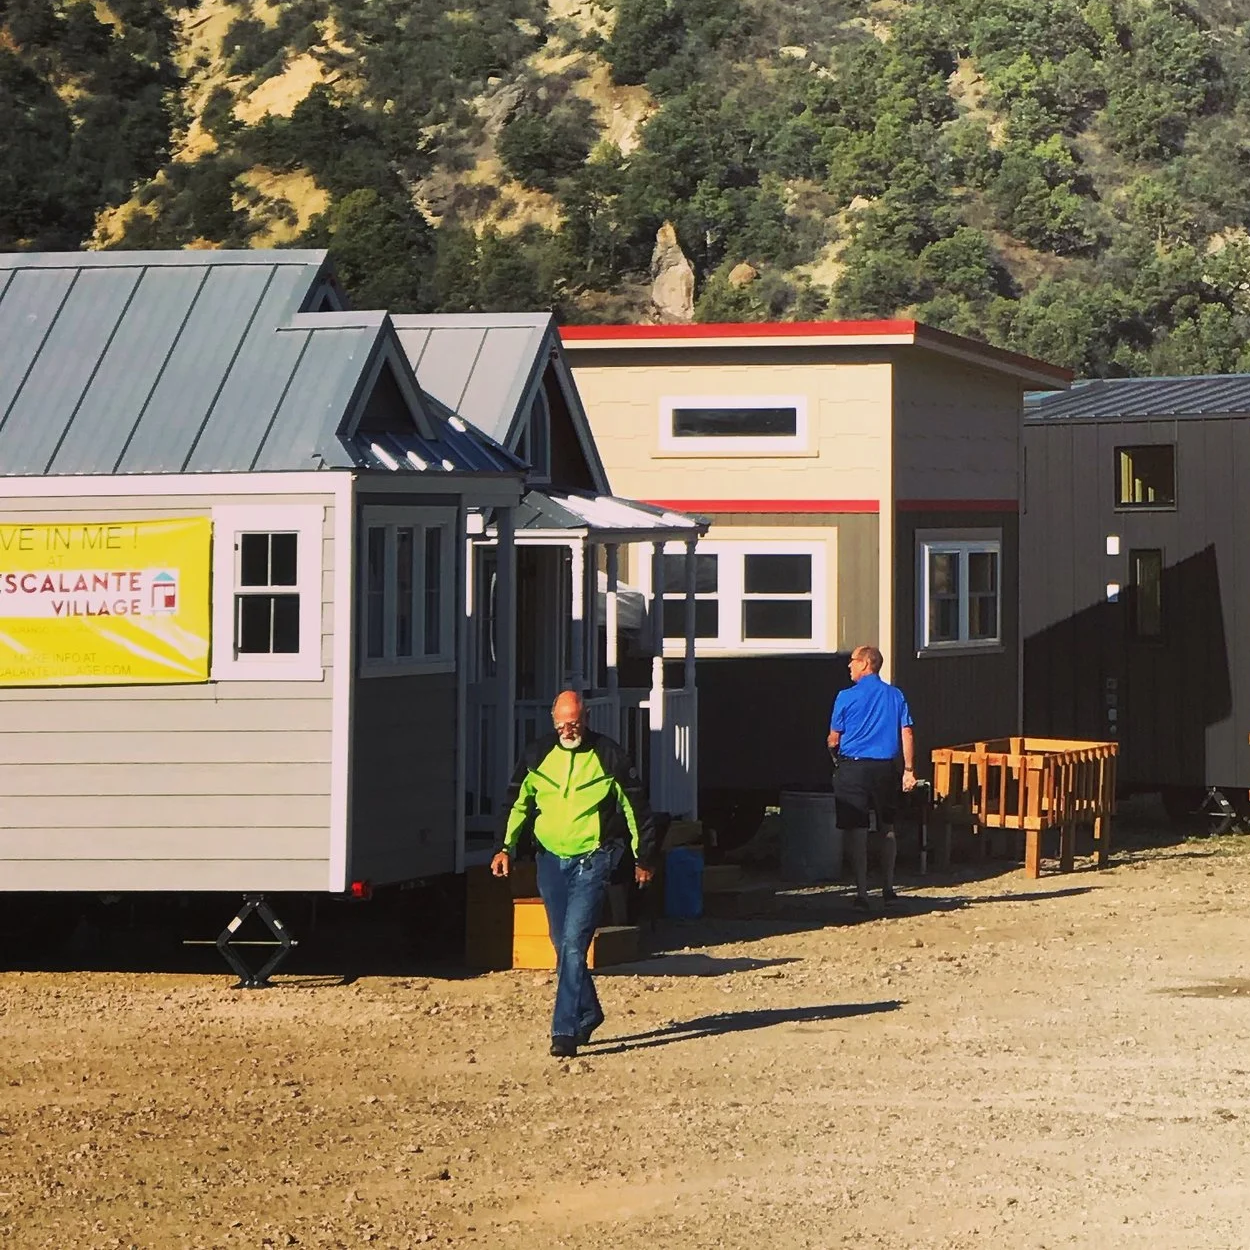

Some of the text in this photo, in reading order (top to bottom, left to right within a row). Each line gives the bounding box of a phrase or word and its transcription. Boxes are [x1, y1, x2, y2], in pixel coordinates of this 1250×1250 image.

[46, 528, 71, 551] IN
[82, 526, 122, 550] ME
[47, 554, 64, 566] AT
[0, 572, 142, 593] SCALANTE
[51, 600, 141, 617] VILLAGE
[53, 653, 81, 663] INFO
[83, 652, 97, 663] AT
